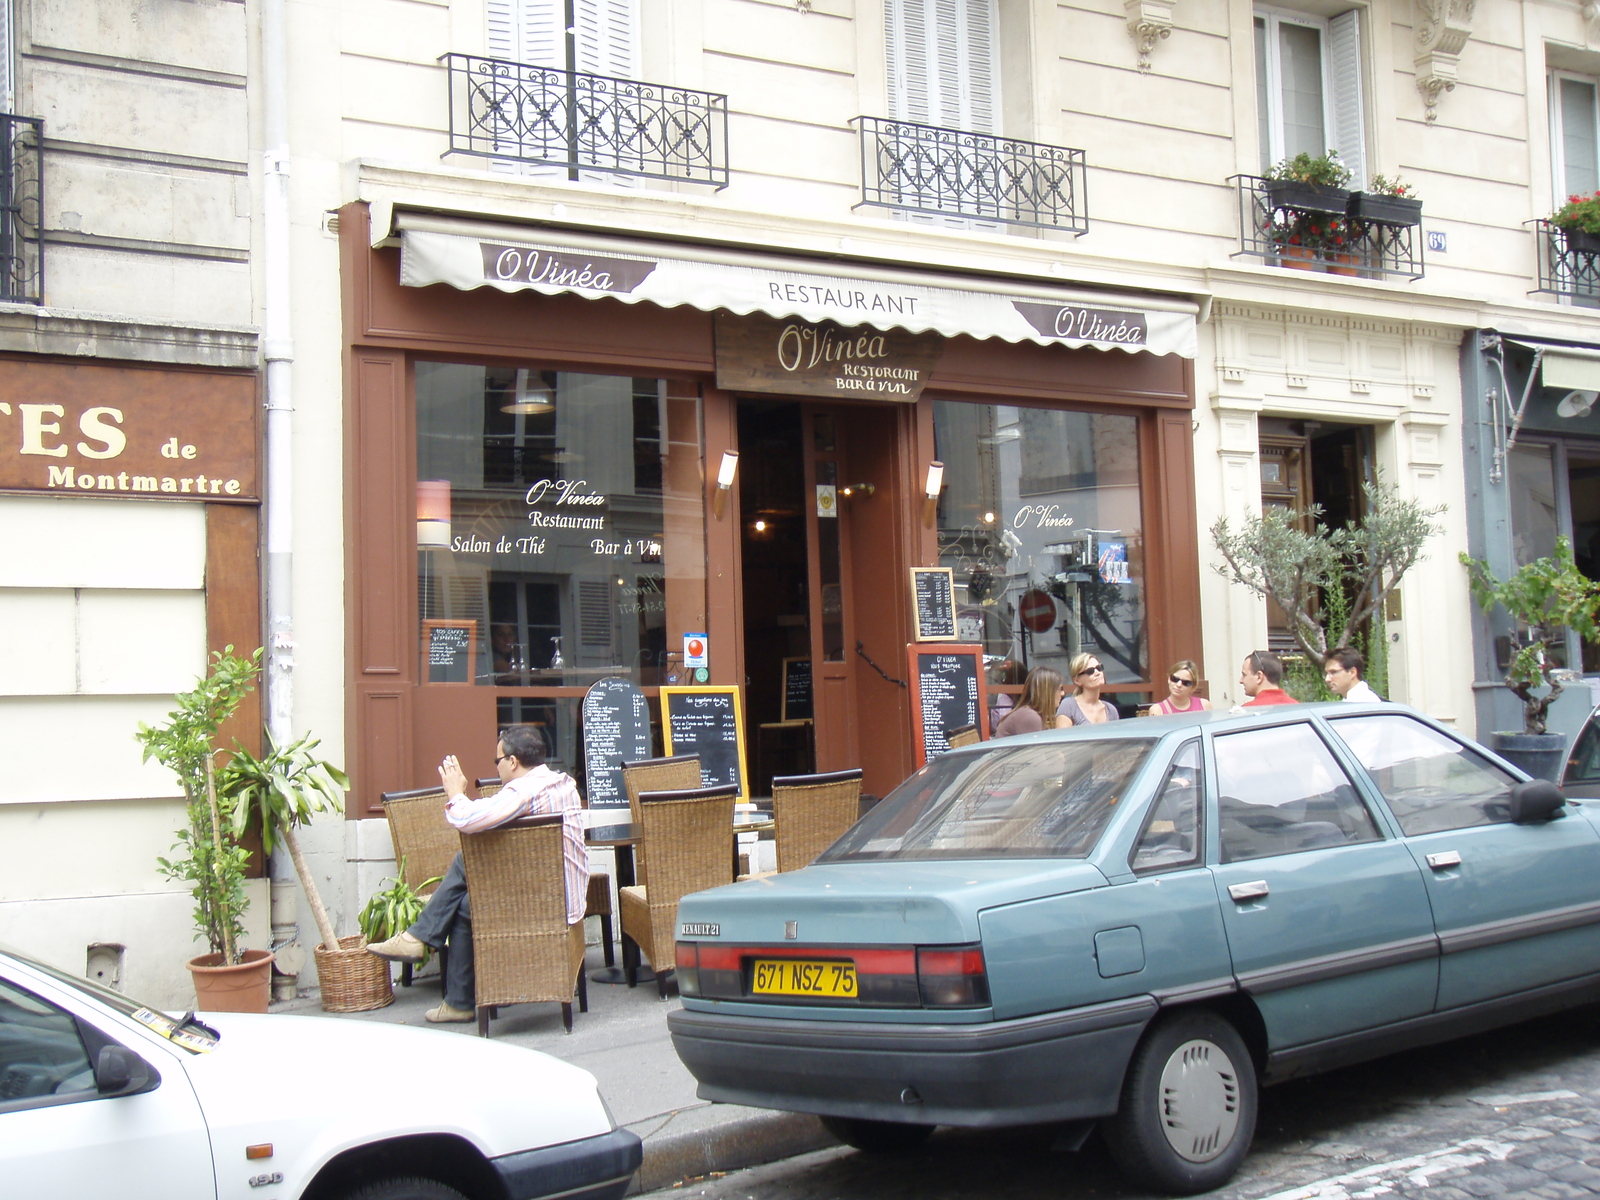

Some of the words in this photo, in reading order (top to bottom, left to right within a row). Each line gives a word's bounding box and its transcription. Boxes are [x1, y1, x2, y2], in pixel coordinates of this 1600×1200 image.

[1429, 232, 1445, 250] 69
[769, 282, 918, 315] RESTAURANT
[0, 402, 127, 460] ES
[161, 437, 197, 460] de
[48, 465, 241, 495] Montmartre
[528, 511, 605, 530] Restaurant
[450, 534, 491, 553] Salon
[496, 535, 512, 553] de
[516, 536, 546, 554] Thé
[590, 539, 620, 555] Bar
[623, 539, 633, 555] à
[636, 540, 662, 556] Vin
[757, 963, 784, 990] 671
[791, 964, 823, 991] NSZ
[831, 966, 854, 993] 75
